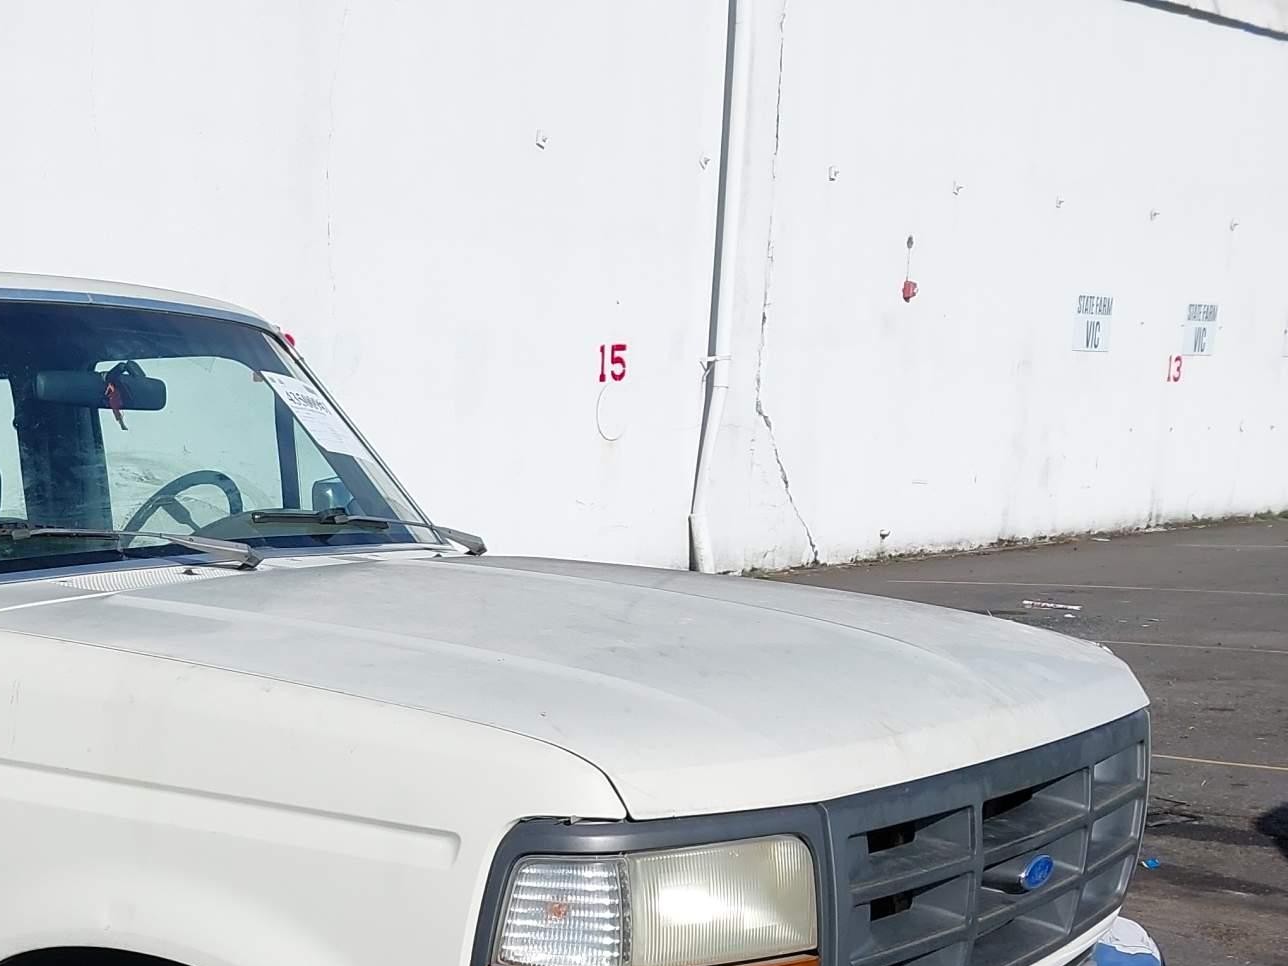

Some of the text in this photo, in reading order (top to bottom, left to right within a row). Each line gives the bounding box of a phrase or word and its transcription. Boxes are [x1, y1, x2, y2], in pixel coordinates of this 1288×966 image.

[1077, 294, 1114, 316] STATE FARM
[1085, 319, 1101, 349] VIC
[1193, 326, 1207, 353] VIC
[599, 344, 627, 382] 15
[1166, 354, 1183, 382] 13
